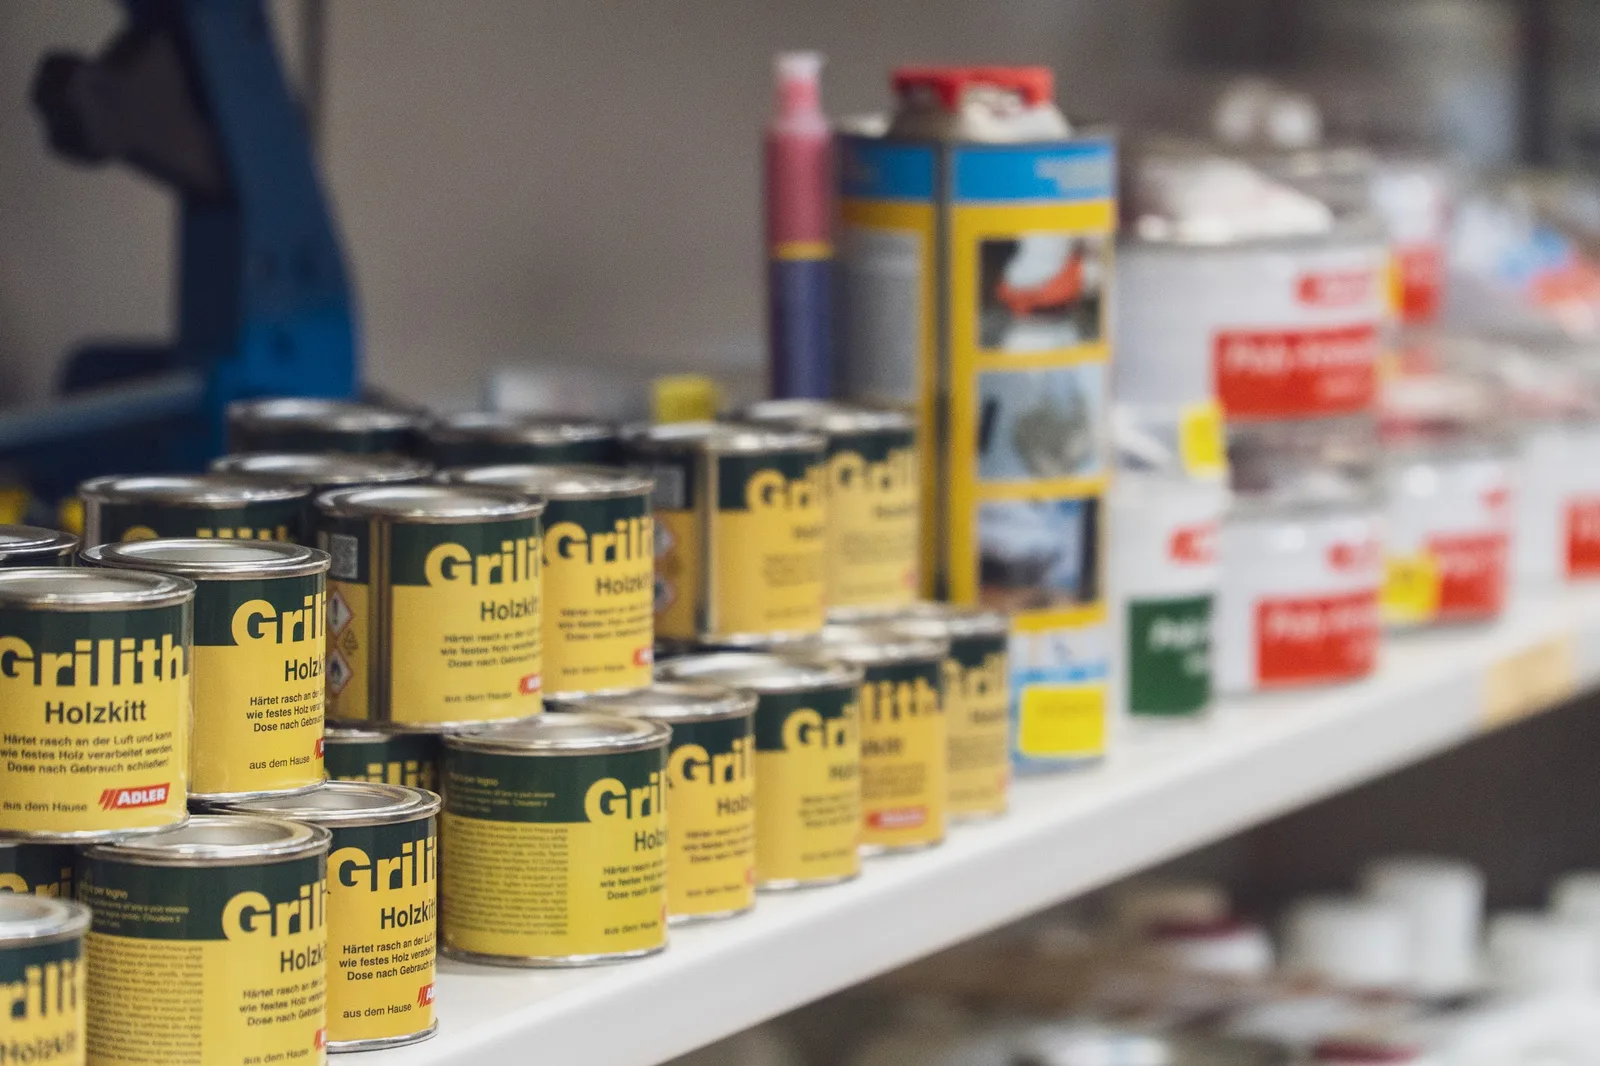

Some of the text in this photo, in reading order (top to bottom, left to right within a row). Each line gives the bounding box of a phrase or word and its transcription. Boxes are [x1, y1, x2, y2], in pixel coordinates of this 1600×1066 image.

[0, 634, 187, 688] Grilith
[250, 696, 279, 706] Härtet
[281, 692, 303, 704] rasch
[304, 691, 312, 701] an
[45, 699, 147, 725] Holzkitt
[246, 709, 264, 720] wie
[266, 708, 292, 719] festes
[294, 705, 309, 716] Holz
[254, 723, 278, 733] Dose
[280, 719, 300, 731] nach
[249, 754, 310, 770] aus dem Hause
[117, 786, 167, 807] ADLER
[343, 944, 374, 955] Härtet
[376, 941, 401, 953] rasch
[402, 939, 412, 949] an
[413, 937, 424, 947] der
[339, 958, 358, 968] wie
[360, 956, 390, 967] festes
[391, 952, 409, 964] Holz
[347, 960, 430, 981] Dose nach Gebrauch
[343, 1003, 412, 1019] aus dem Hause
